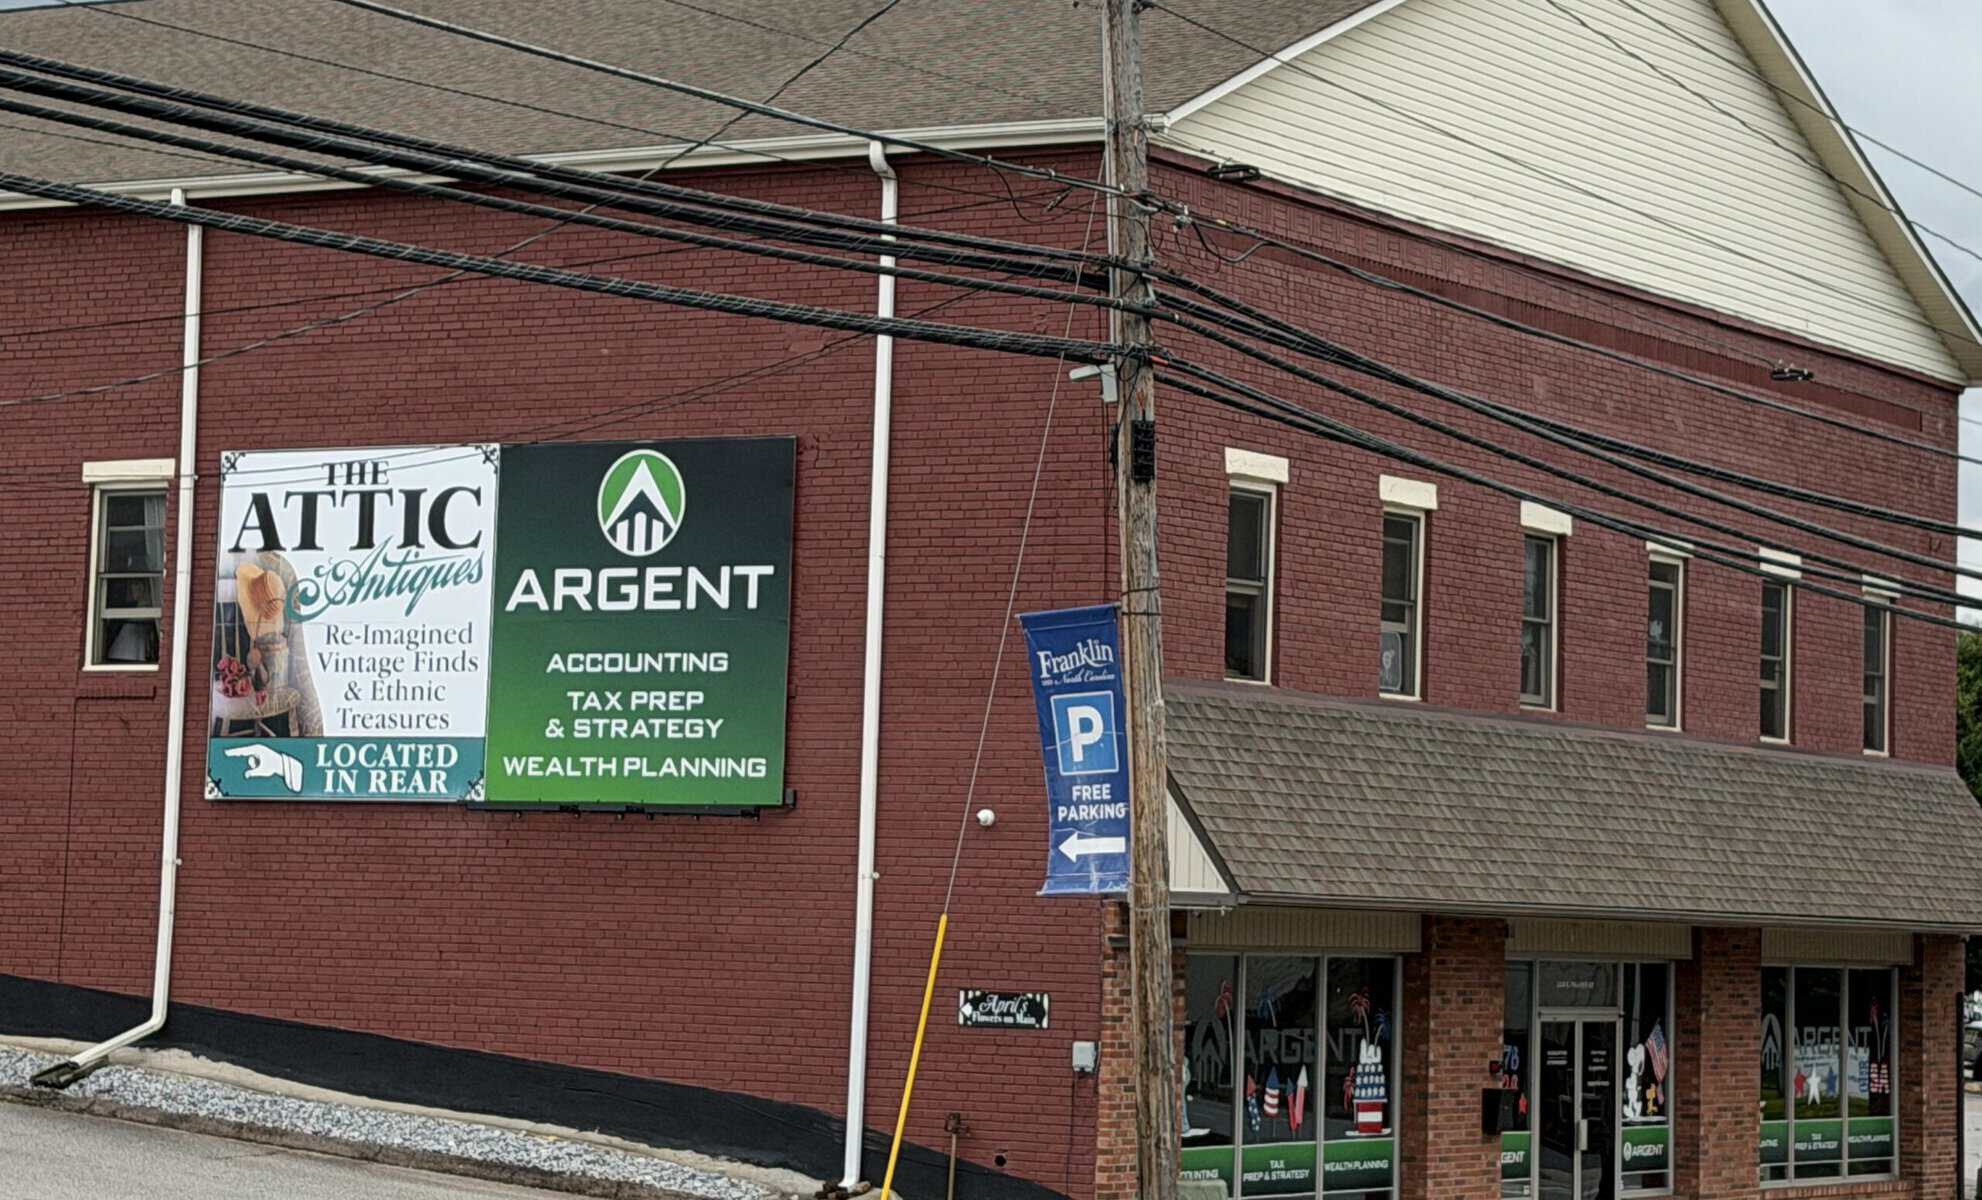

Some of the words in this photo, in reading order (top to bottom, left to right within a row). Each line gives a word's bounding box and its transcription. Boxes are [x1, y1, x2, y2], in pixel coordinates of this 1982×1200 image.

[322, 460, 390, 486] THE
[227, 486, 483, 554] ATTIC
[286, 535, 485, 623] Antiques
[505, 565, 775, 611] ARGENT
[325, 621, 474, 650] Re-Imagined
[318, 651, 405, 678] Vintage
[413, 651, 479, 673] Finds
[546, 652, 729, 673] ACCOUNTING
[1036, 638, 1114, 679] Franklin
[344, 682, 362, 701] &
[372, 680, 446, 701] Ethnic
[567, 691, 623, 711] TAX
[630, 690, 704, 711] PREP
[337, 707, 449, 730] Treasures
[545, 719, 564, 739] &
[573, 718, 724, 739] STRATEGY
[1067, 705, 1104, 762] P
[316, 744, 458, 768] LOCATED
[503, 756, 617, 777] WEALTH
[624, 757, 767, 778] PLANNING
[324, 771, 358, 793] IN
[369, 771, 448, 794] REAR
[1072, 784, 1111, 801] FREE
[1058, 803, 1127, 822] PARKING
[979, 994, 1028, 1014] April's
[1244, 1027, 1363, 1064] ARGENT
[1793, 1026, 1872, 1055] ARGENT
[1501, 1151, 1525, 1164] GENT
[1632, 1144, 1664, 1157] ARGENT
[1243, 1172, 1263, 1182] PREP
[1271, 1169, 1310, 1180] STRATEGY
[1270, 1160, 1285, 1169] TAX
[1324, 1162, 1351, 1172] WEALTH
[1352, 1160, 1389, 1170] PLANNING
